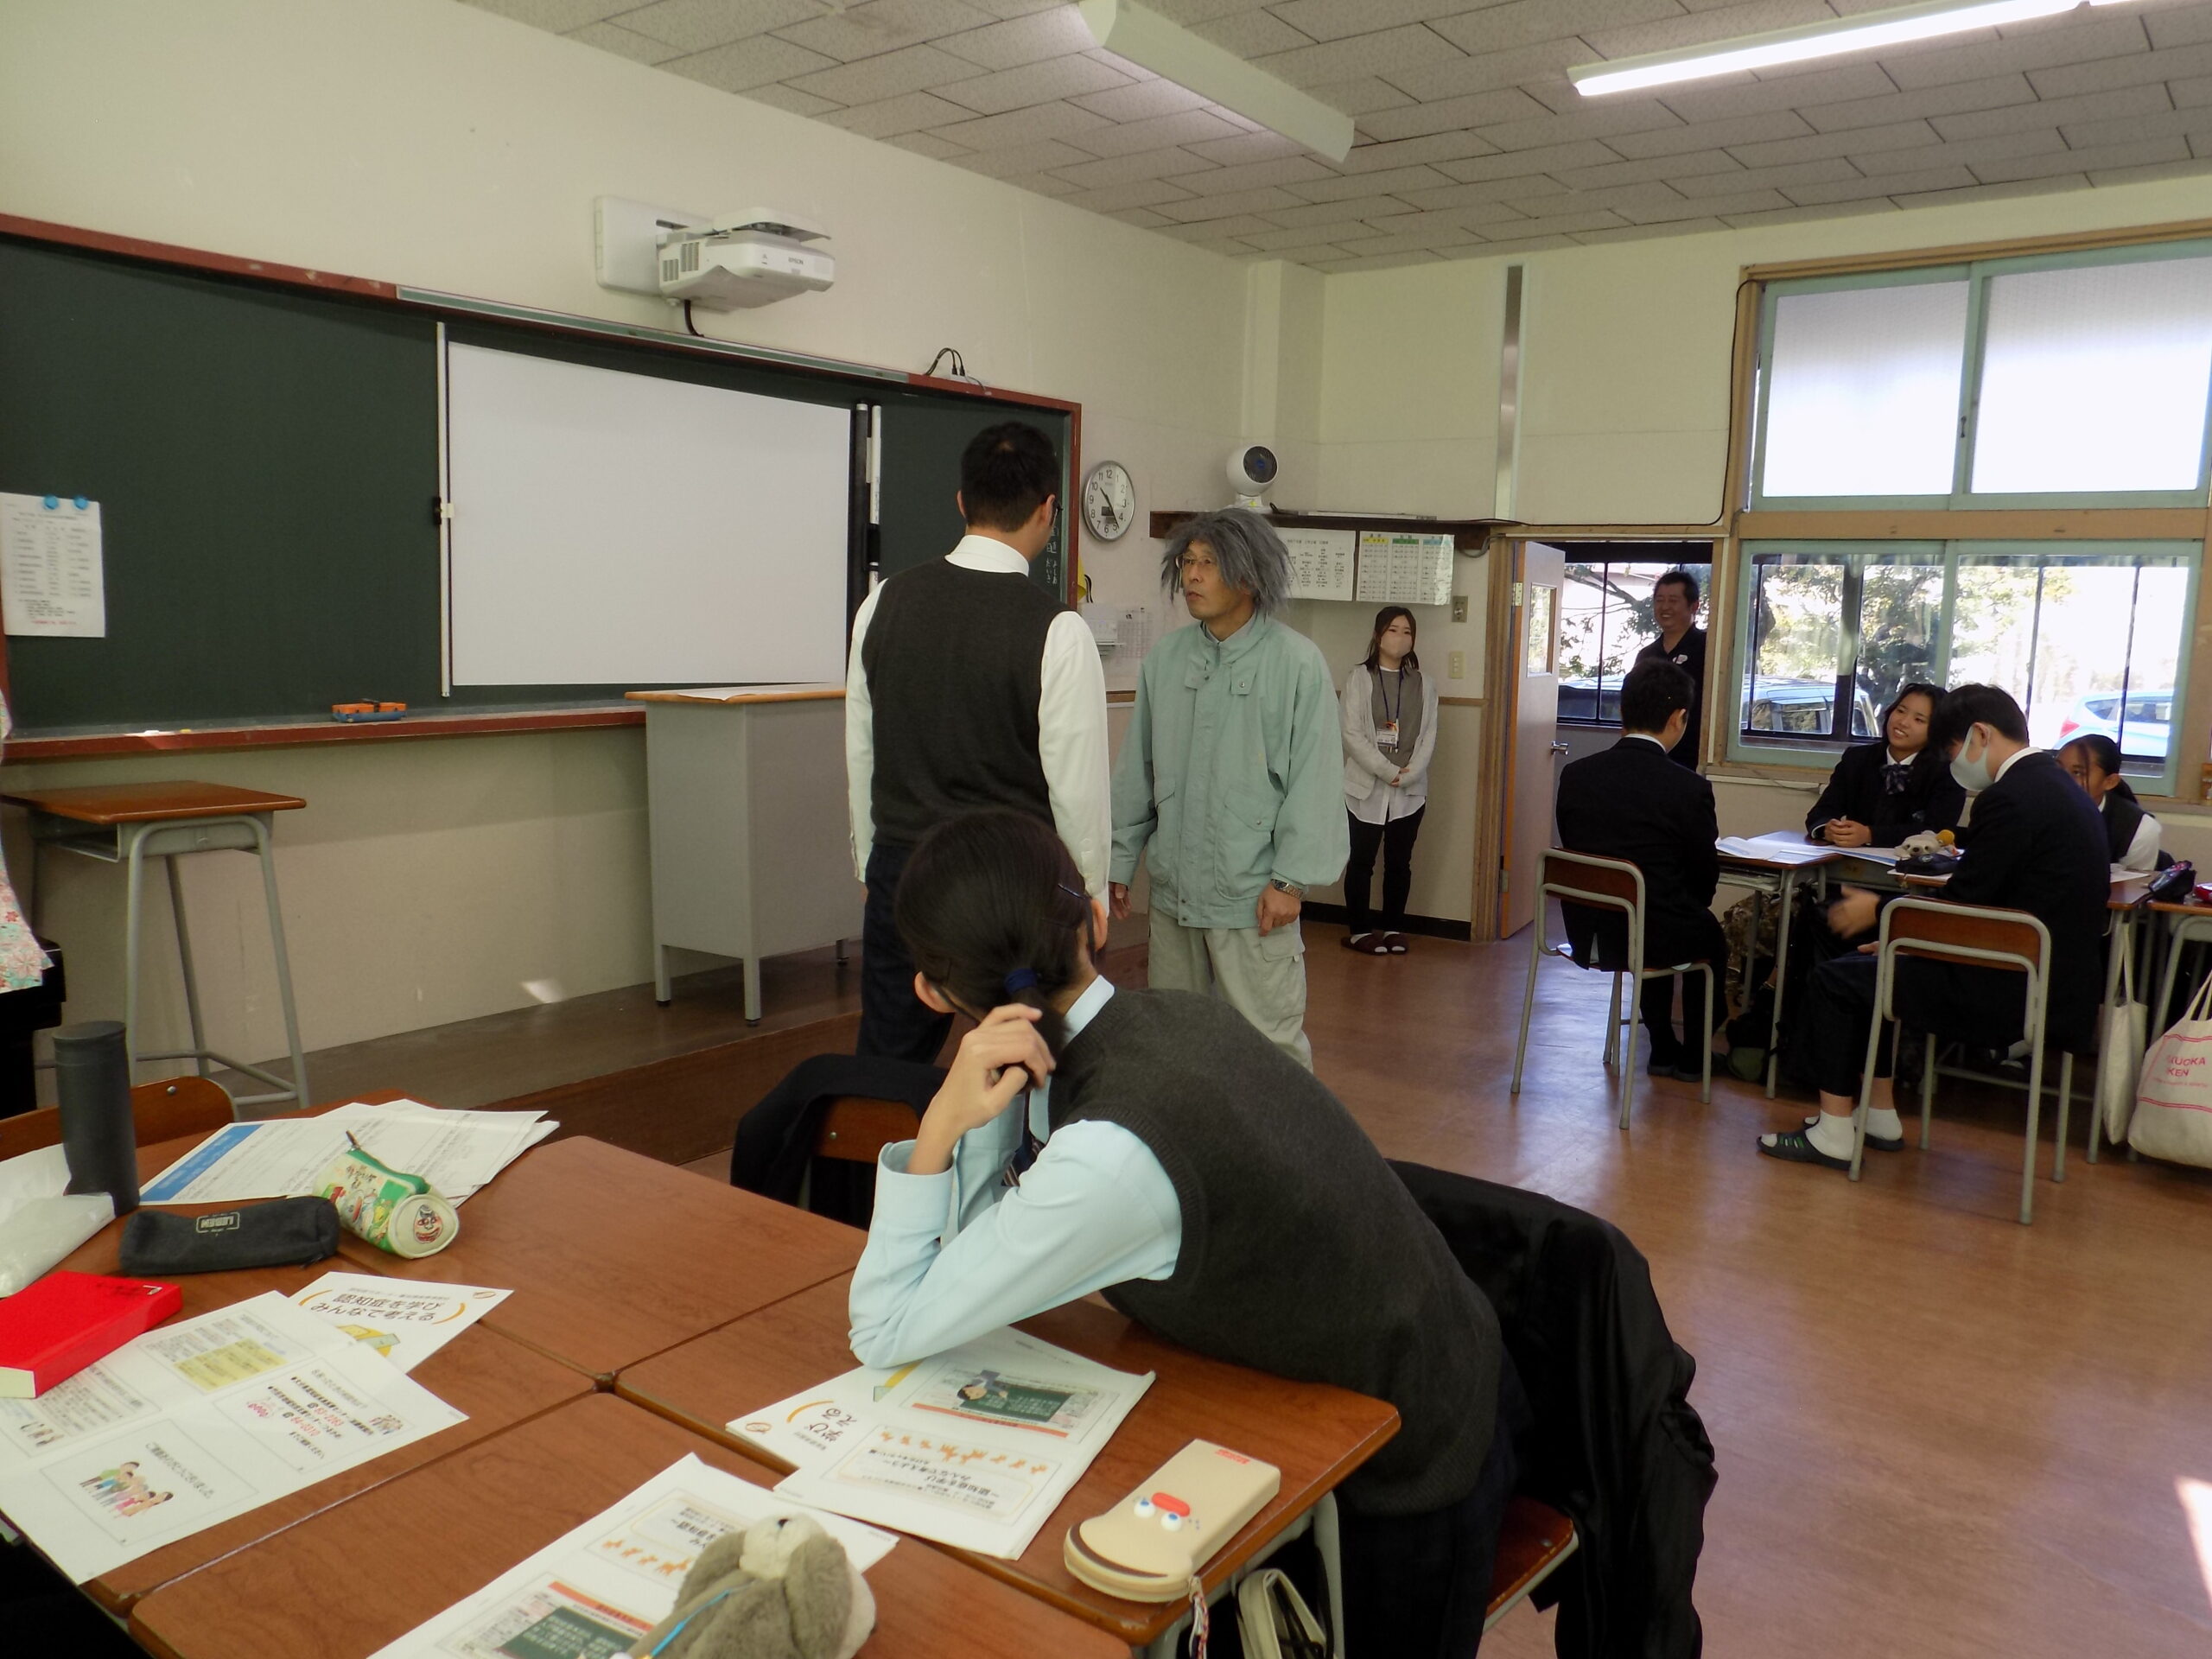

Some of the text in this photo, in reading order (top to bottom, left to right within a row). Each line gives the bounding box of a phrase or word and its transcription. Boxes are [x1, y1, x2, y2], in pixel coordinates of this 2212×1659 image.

[1099, 472, 1103, 480] 11
[1106, 469, 1112, 479] 12
[1092, 481, 1098, 491] 10
[1121, 485, 1125, 493] 2
[1089, 495, 1094, 504] 9
[1122, 499, 1127, 508] 3
[1090, 509, 1096, 518] 8
[1096, 520, 1101, 530] 7
[1104, 524, 1109, 533] 6
[1113, 521, 1118, 531] 5
[2166, 1068, 2189, 1077] KEN
[332, 1294, 444, 1311] 認知症を学び
[310, 1301, 435, 1321] みんなで考える
